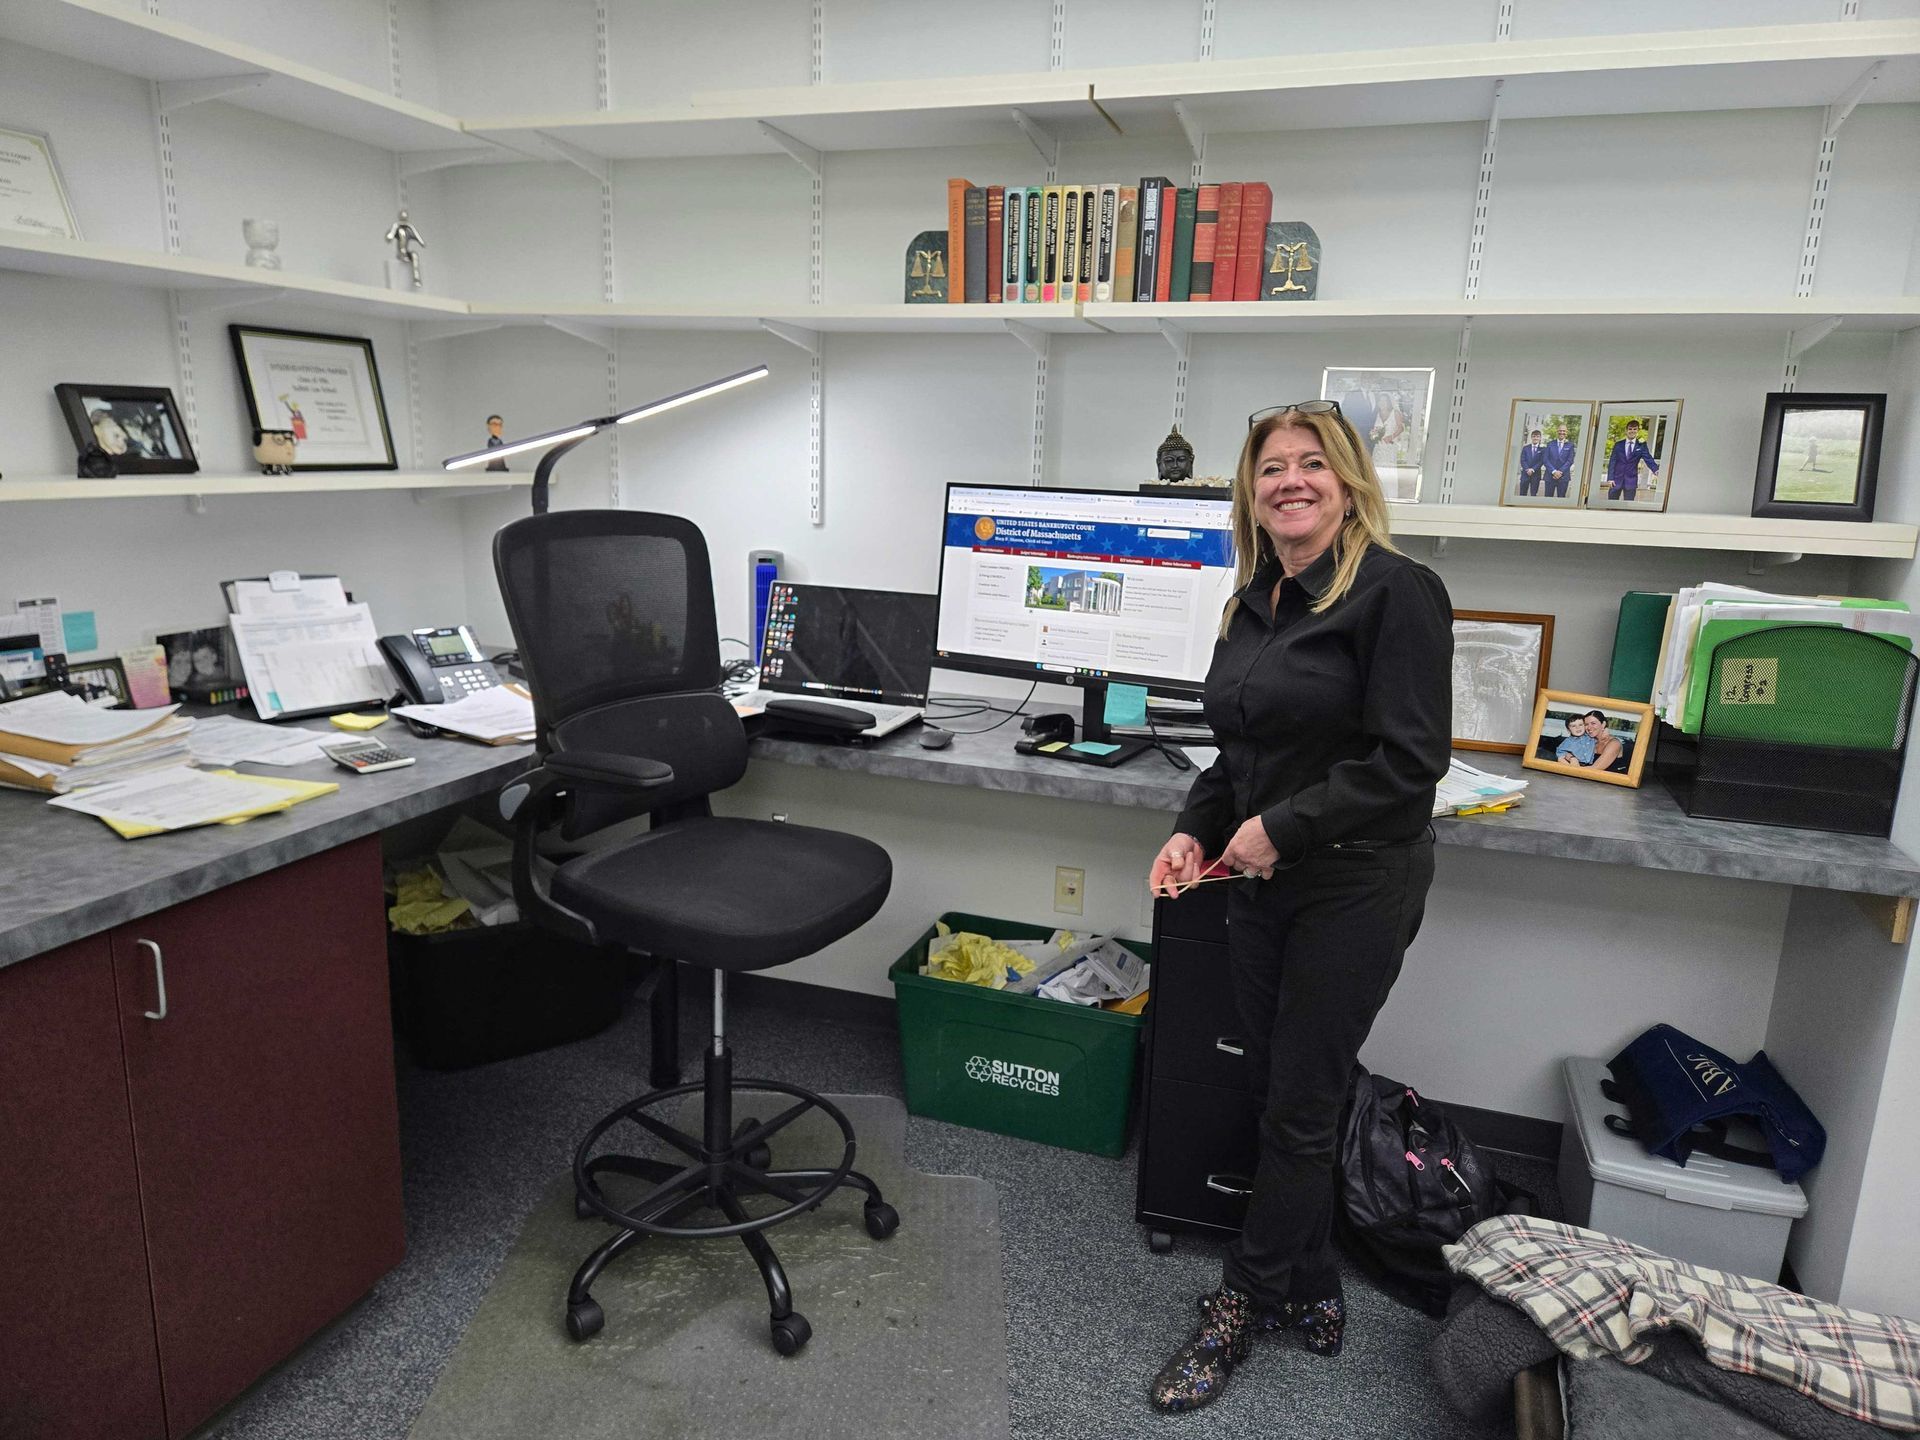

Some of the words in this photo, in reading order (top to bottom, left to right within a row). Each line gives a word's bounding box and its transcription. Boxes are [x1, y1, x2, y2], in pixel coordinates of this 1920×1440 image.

[1146, 188, 1157, 220] ROSENBERG
[1144, 220, 1155, 230] FILE
[996, 527, 1021, 536] District
[1030, 530, 1081, 540] Massachusetts
[1039, 521, 1075, 530] BANKRUPTCY
[992, 1060, 1059, 1086] SUTTON
[992, 1074, 1059, 1096] RECYCLES
